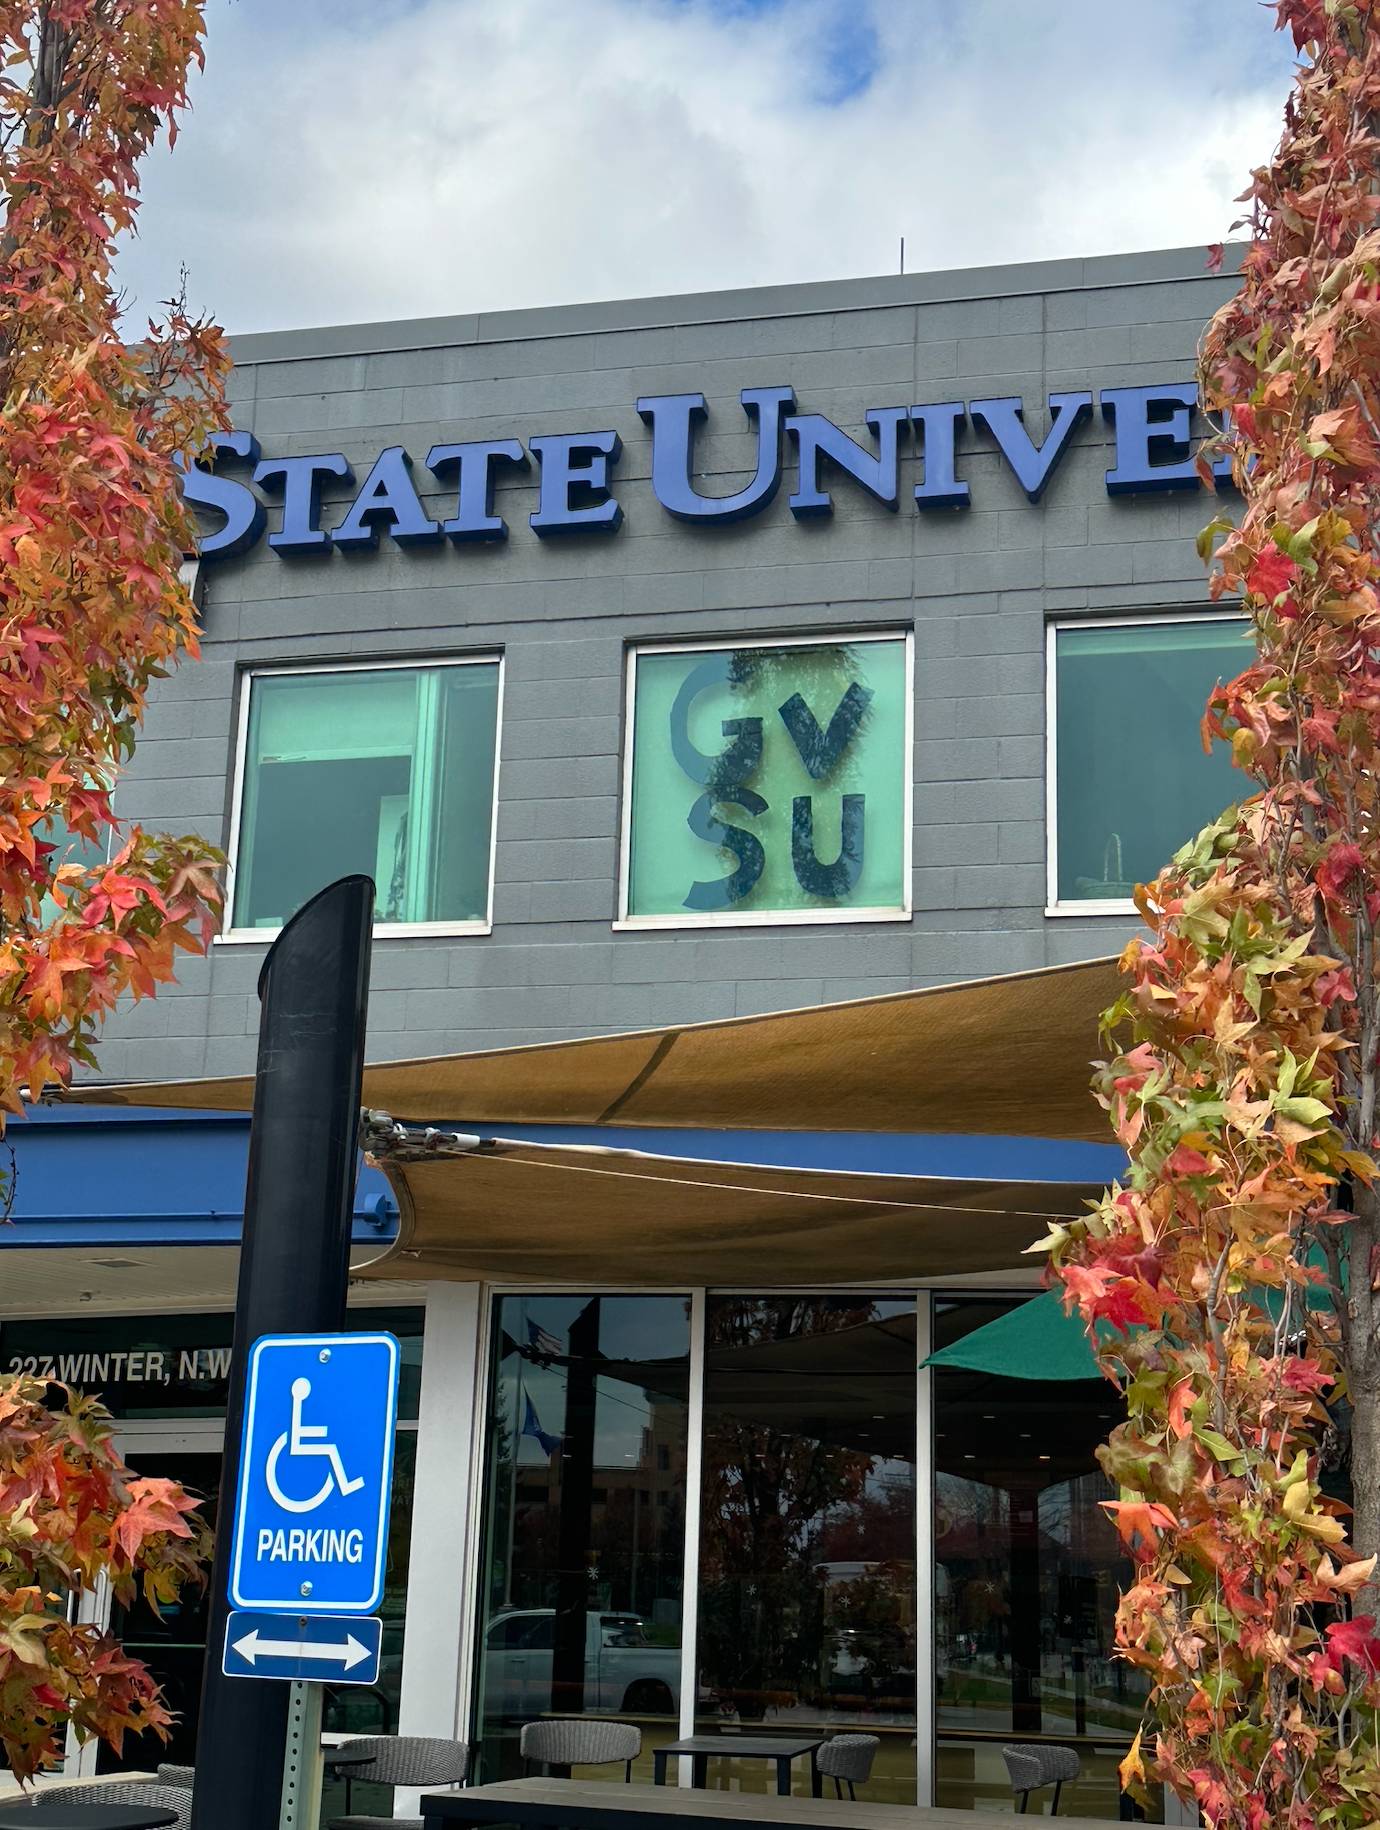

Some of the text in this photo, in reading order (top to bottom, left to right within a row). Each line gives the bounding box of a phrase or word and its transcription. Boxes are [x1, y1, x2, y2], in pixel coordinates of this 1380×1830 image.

[171, 429, 622, 556] STATE
[670, 652, 875, 786] GV
[682, 786, 866, 910] SU
[58, 1351, 170, 1386] WINTER,
[256, 1528, 364, 1563] PARKING
